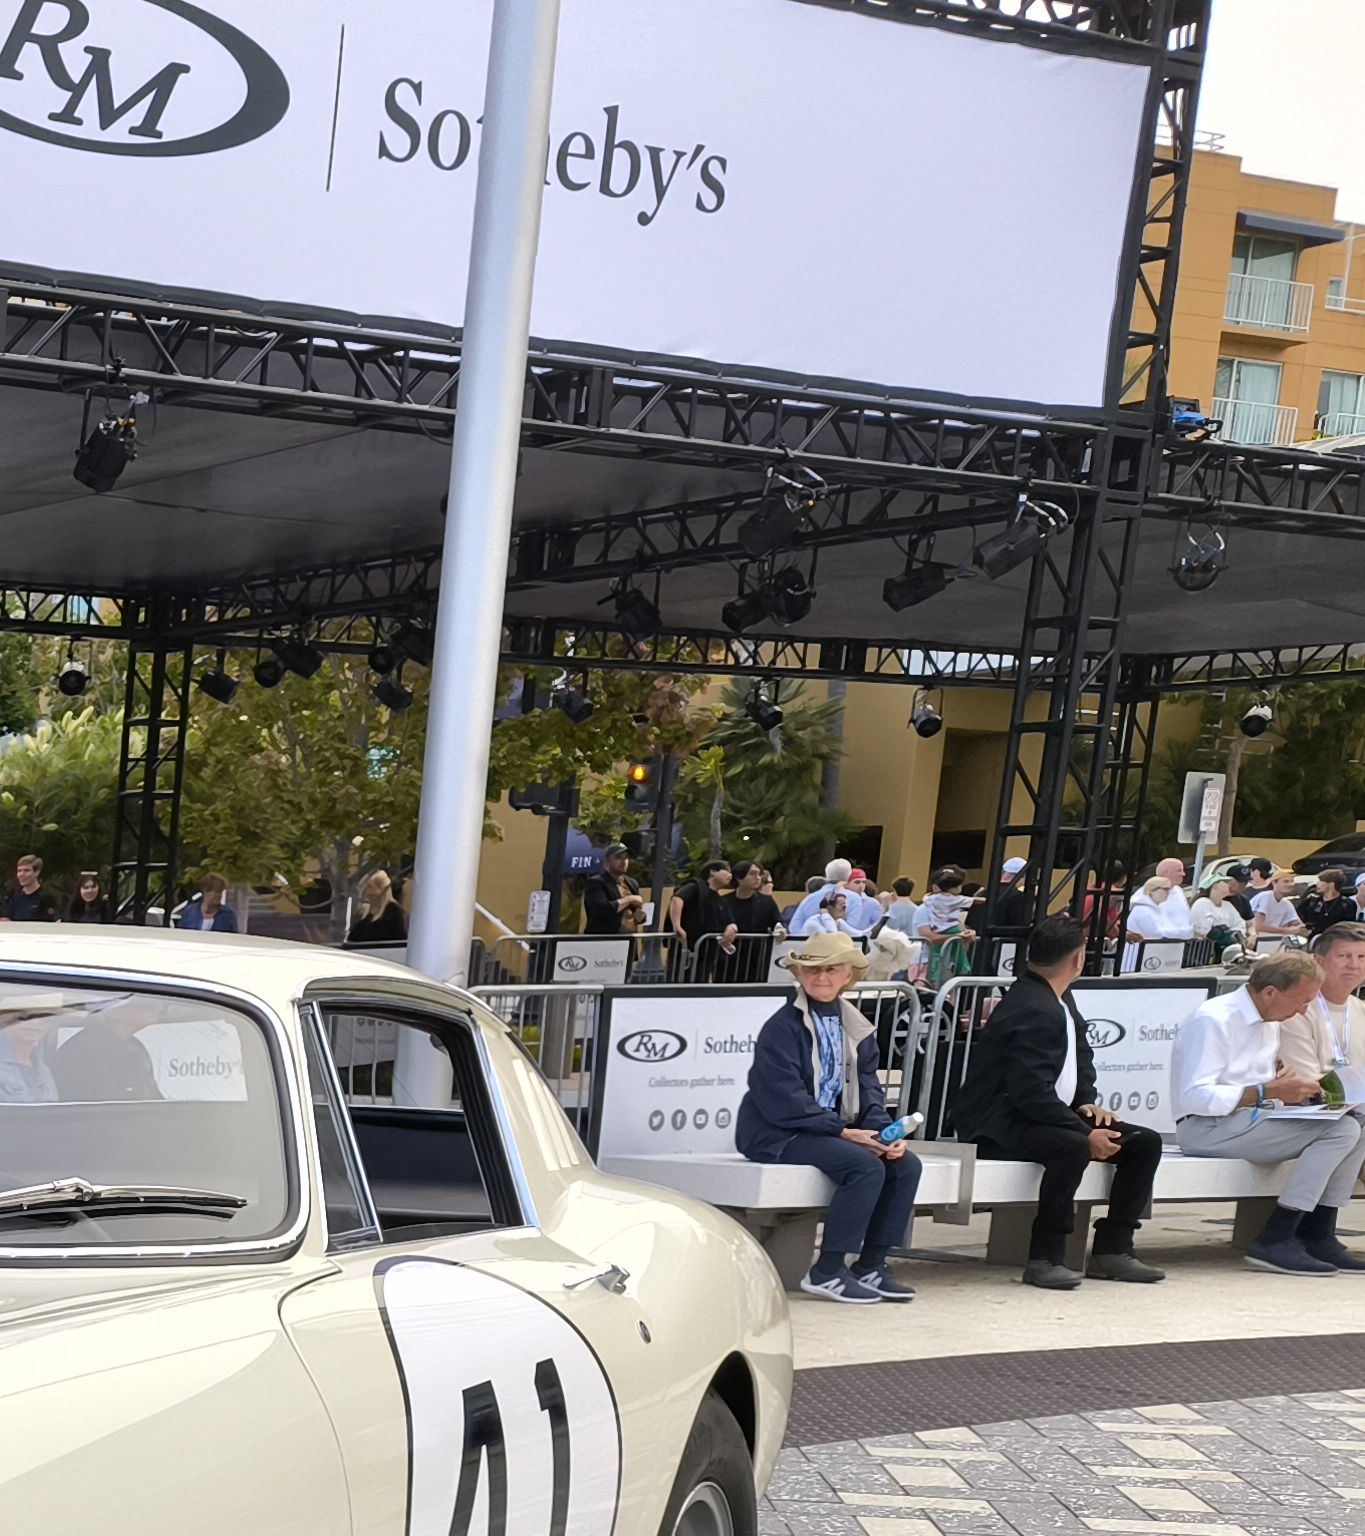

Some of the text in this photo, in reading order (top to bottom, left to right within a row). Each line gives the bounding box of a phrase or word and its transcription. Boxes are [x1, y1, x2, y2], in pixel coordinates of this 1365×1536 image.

[377, 76, 729, 227] Soeby's
[571, 856, 592, 868] FIN
[633, 1034, 671, 1059] RM
